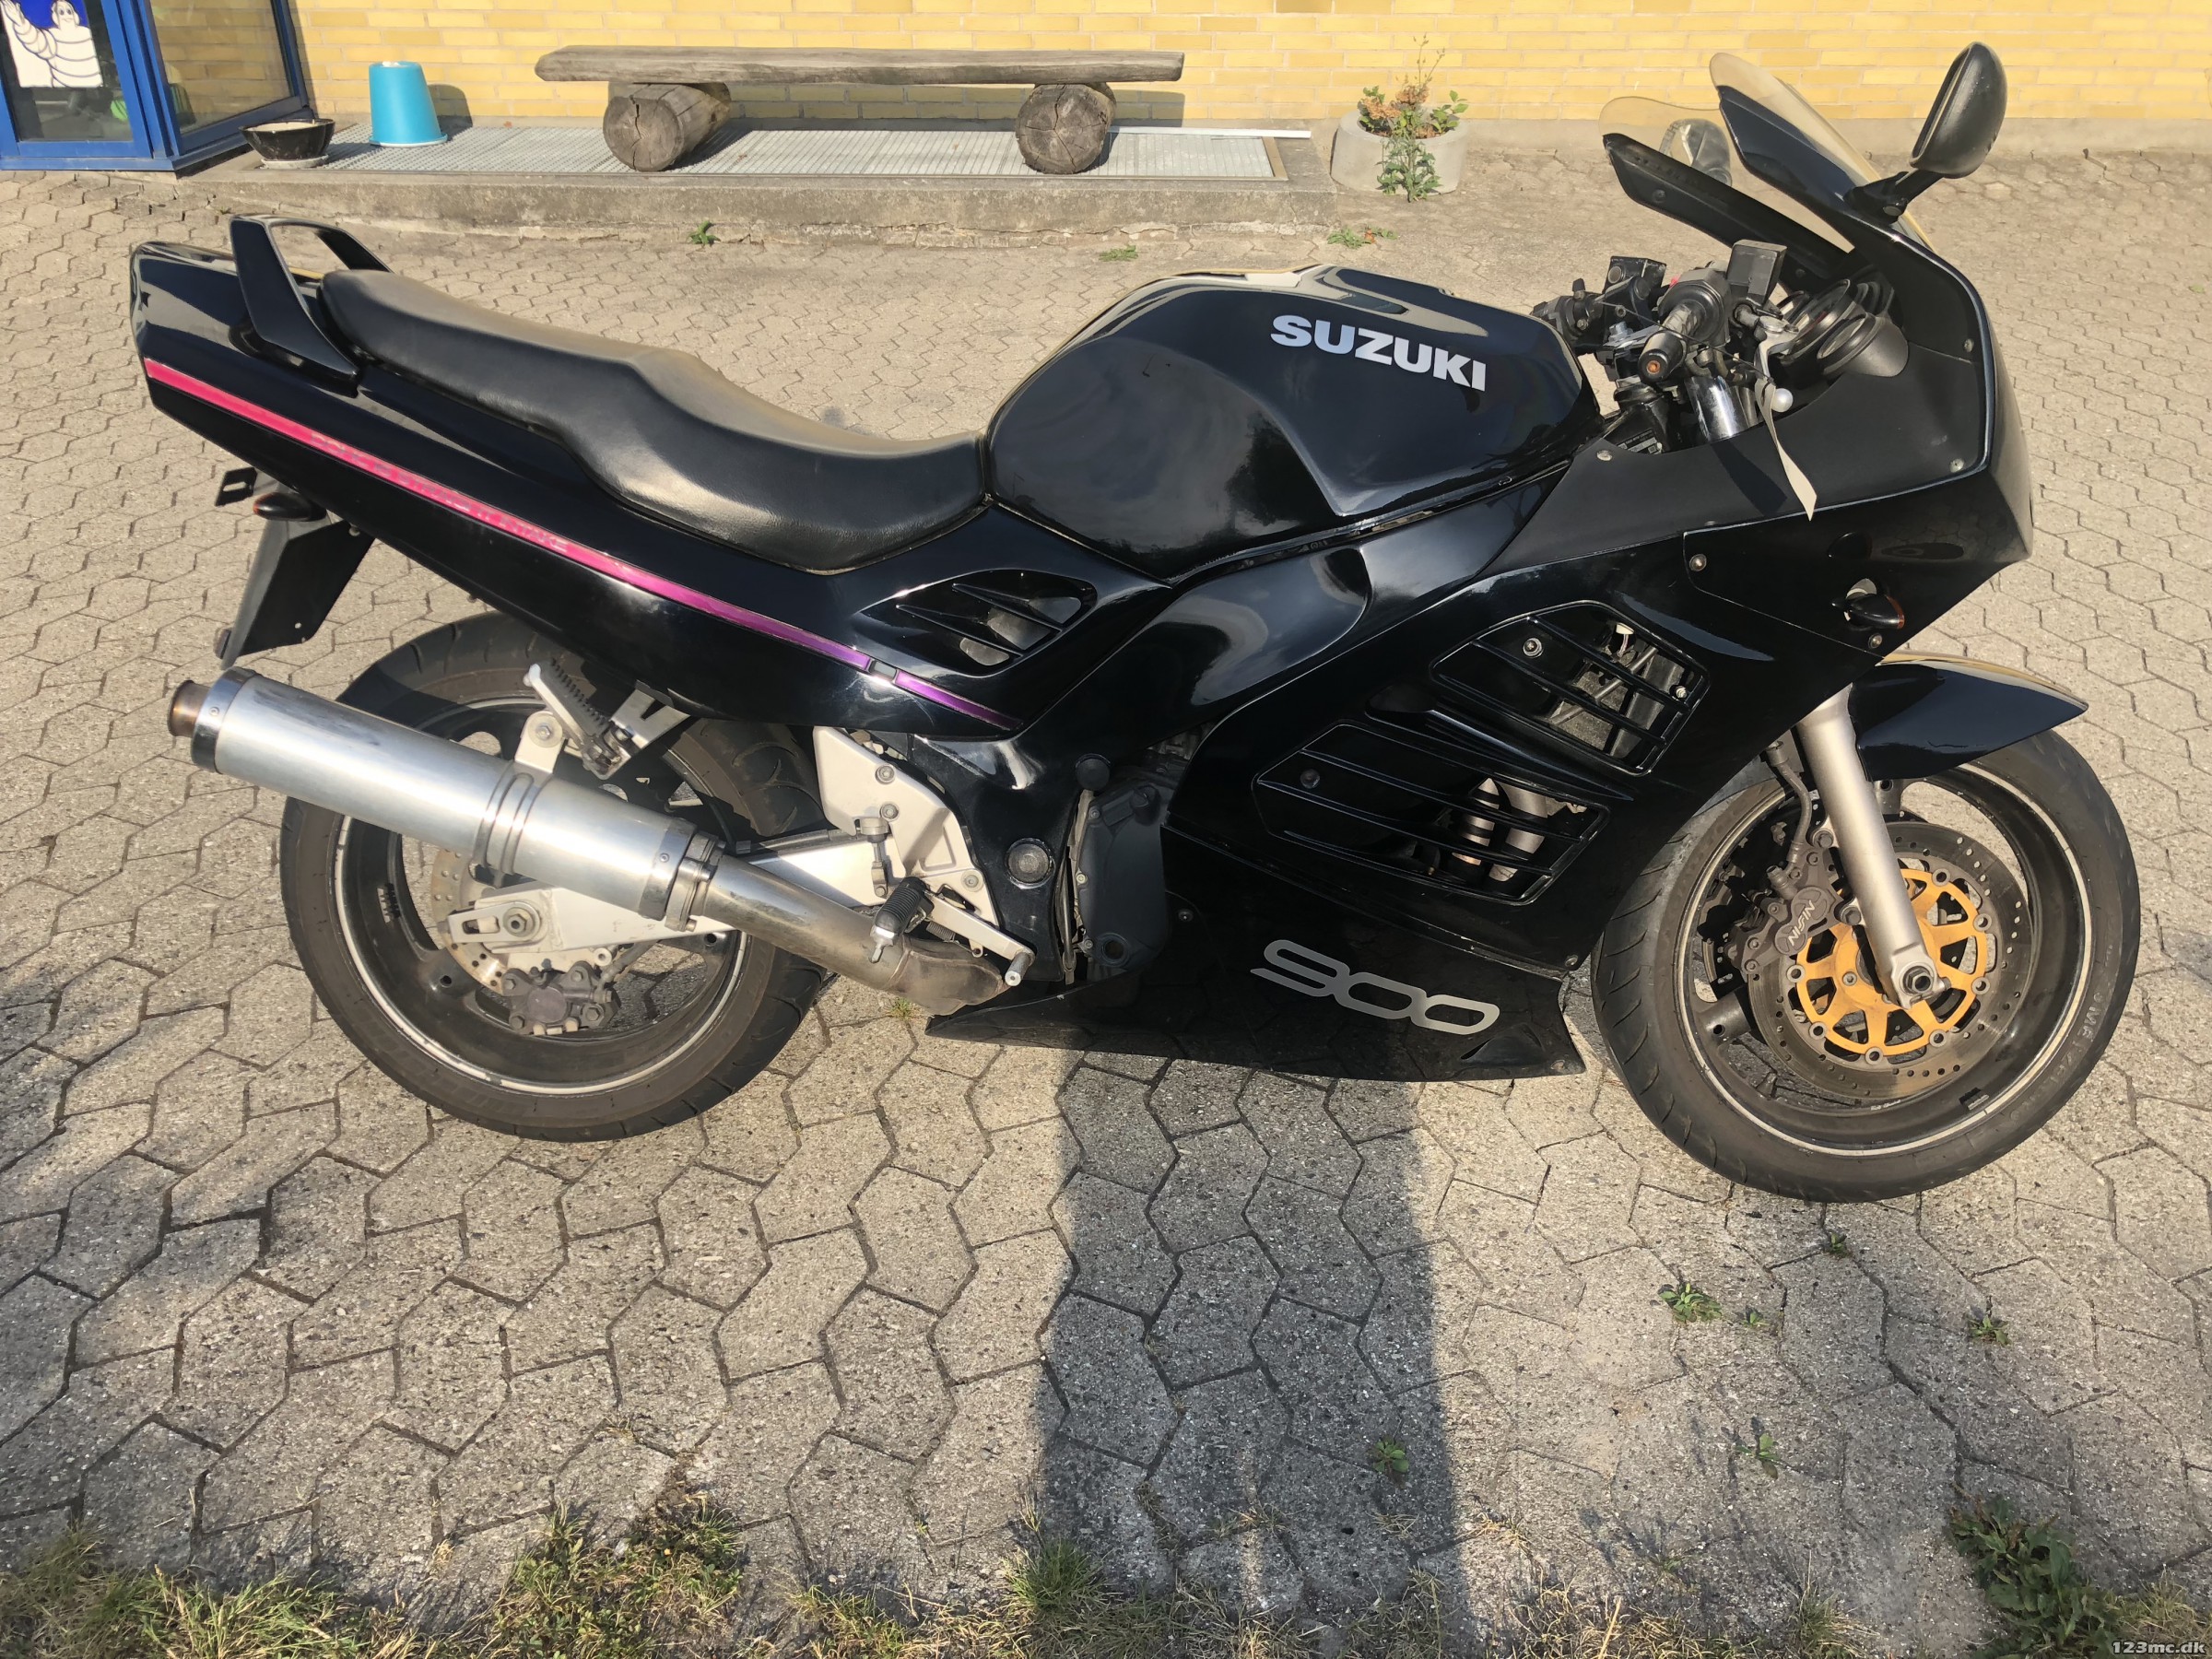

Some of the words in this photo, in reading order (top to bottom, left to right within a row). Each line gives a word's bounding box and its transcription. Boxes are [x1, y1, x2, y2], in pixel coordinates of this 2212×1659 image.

[1270, 314, 1487, 392] SUZUKI
[1788, 900, 1816, 947] NISSIN
[1250, 939, 1500, 1035] 900
